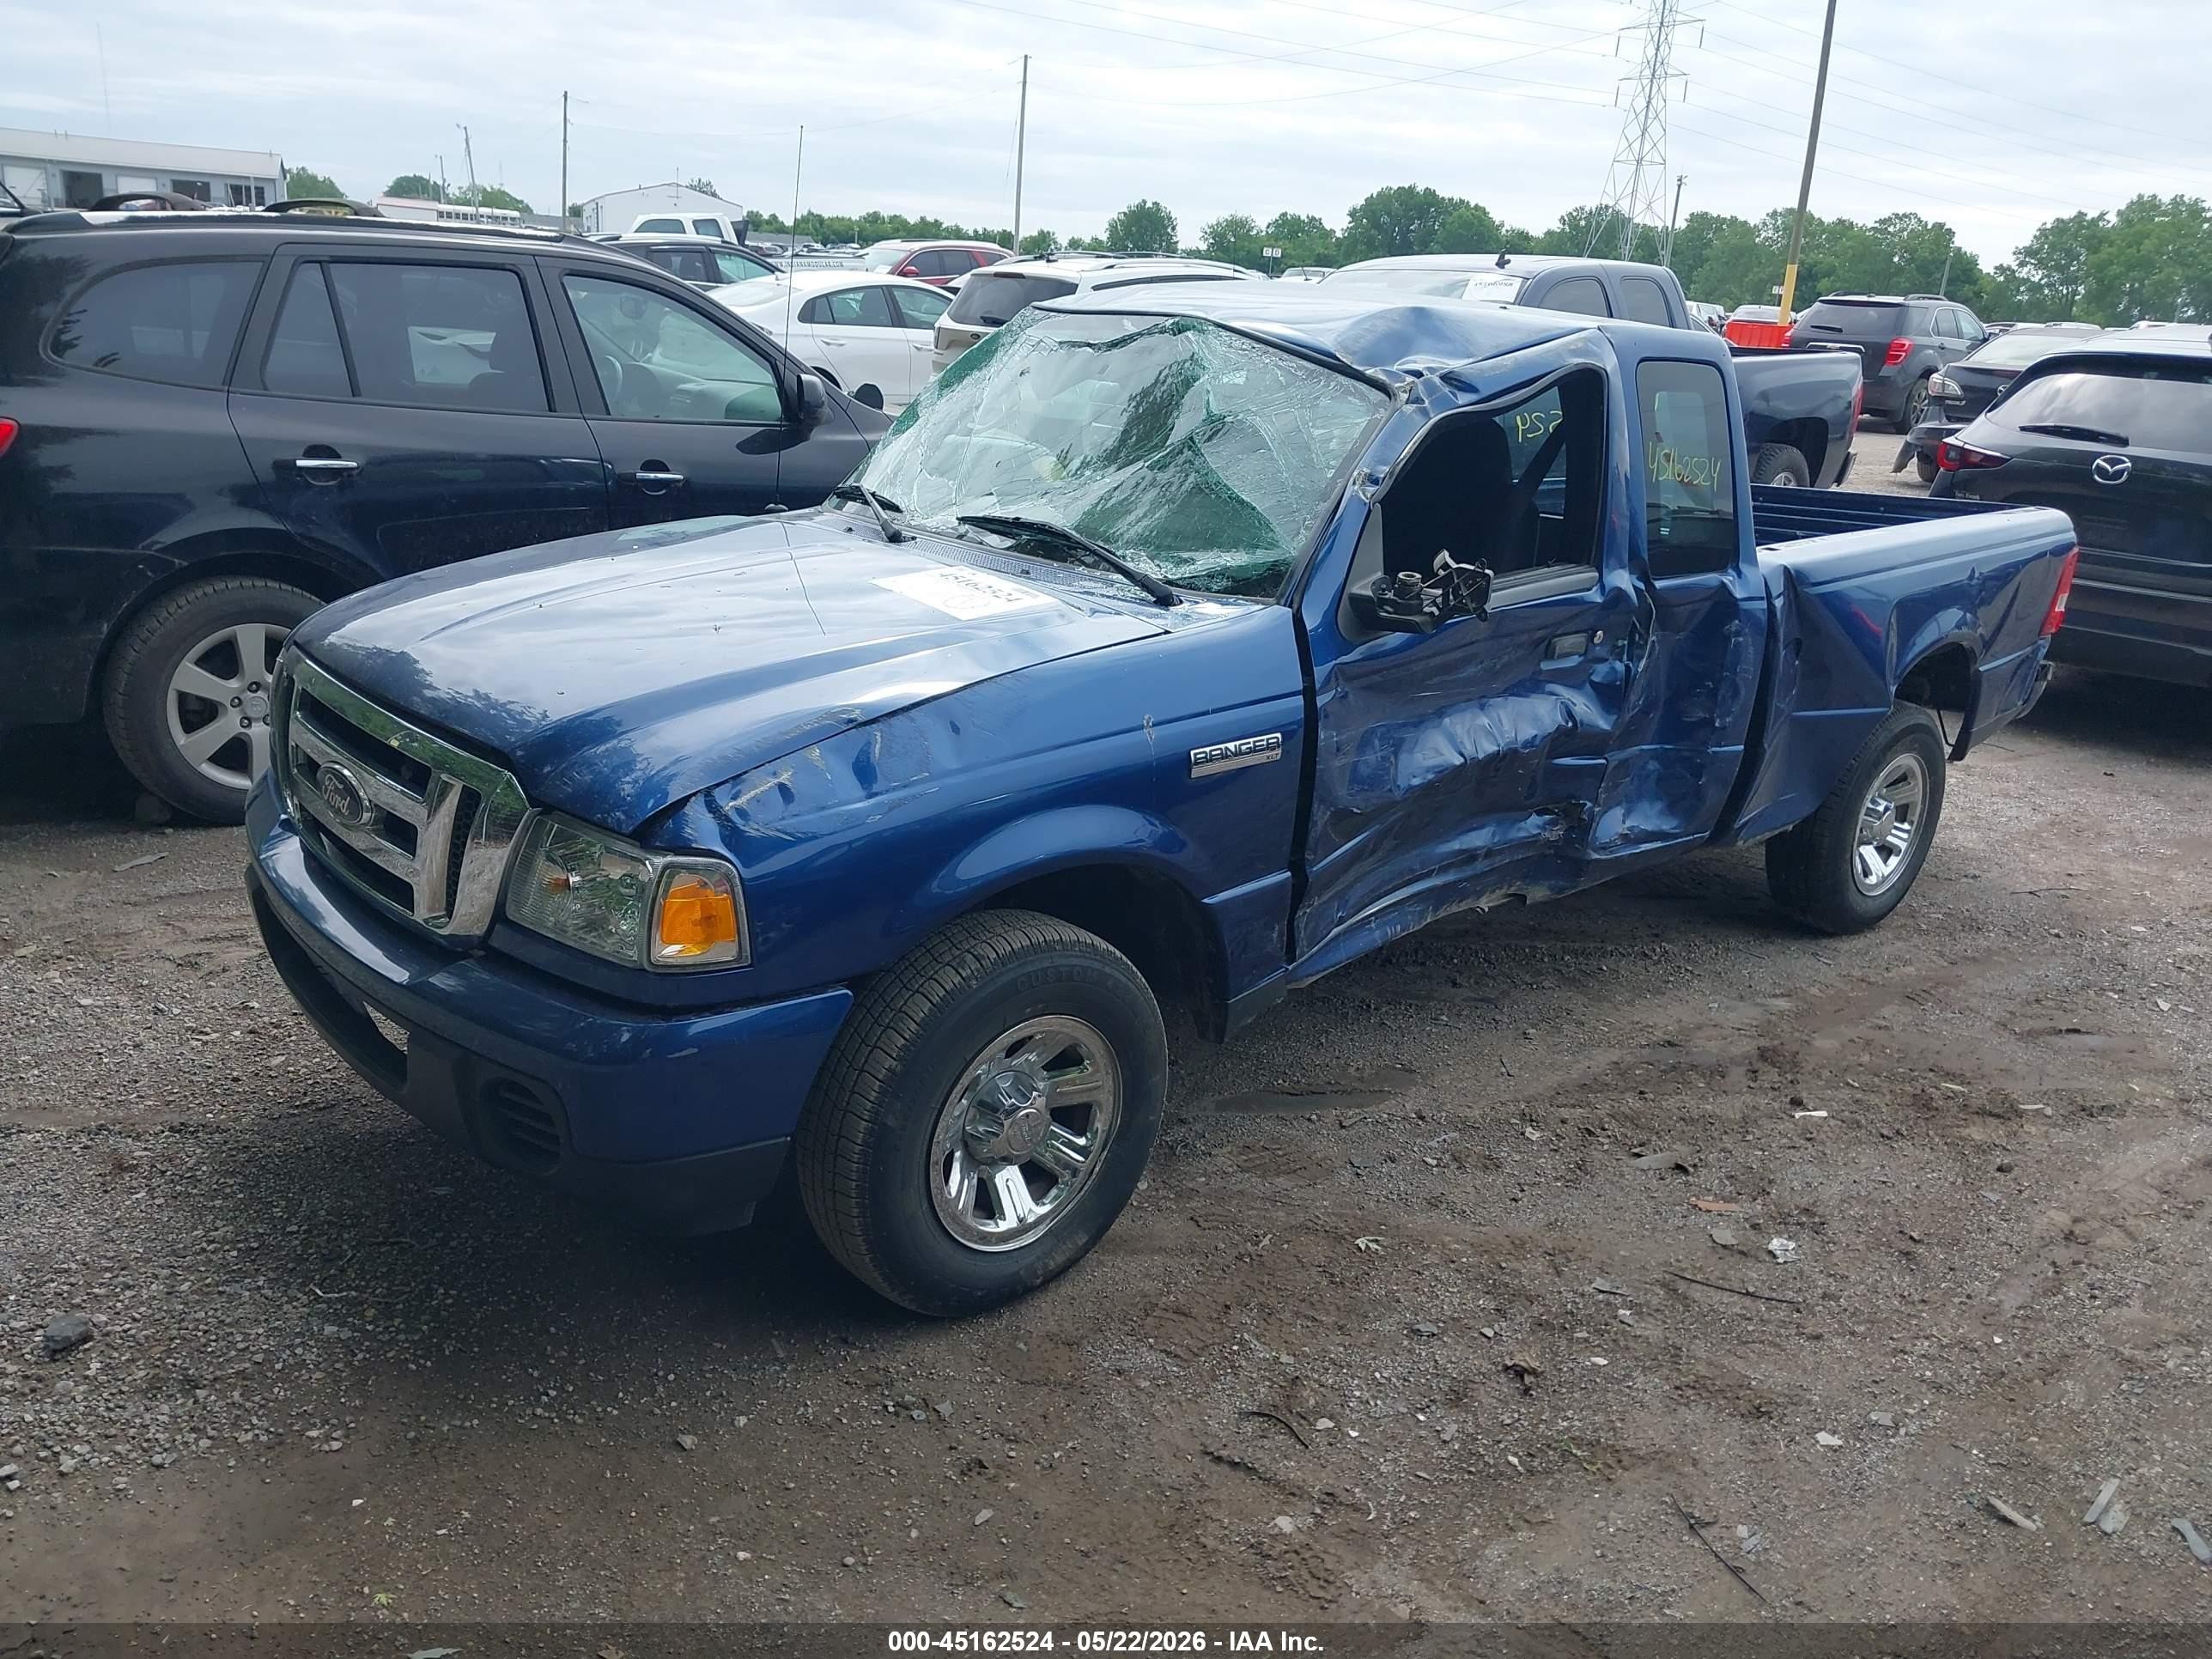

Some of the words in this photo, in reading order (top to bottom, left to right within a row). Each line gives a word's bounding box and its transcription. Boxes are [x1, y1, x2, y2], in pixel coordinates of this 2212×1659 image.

[1649, 441, 1722, 493] 45162524
[1192, 736, 1281, 766] RANGER
[322, 774, 350, 816] Ford
